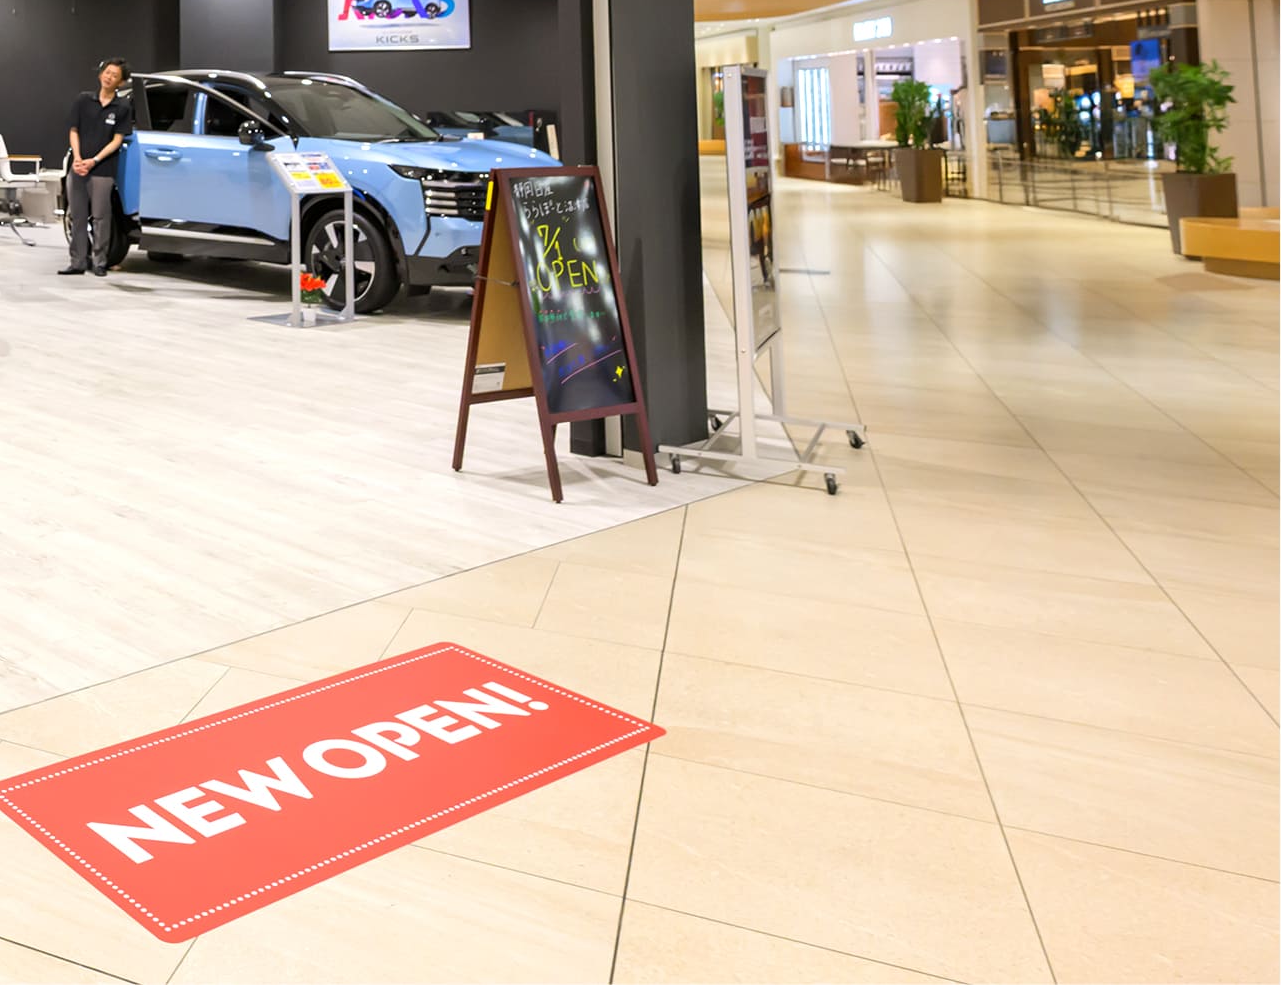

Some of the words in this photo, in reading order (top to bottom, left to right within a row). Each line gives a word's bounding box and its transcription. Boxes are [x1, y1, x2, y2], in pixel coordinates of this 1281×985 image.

[375, 34, 420, 44] KICKS
[537, 259, 599, 292] OPEN
[86, 756, 314, 864] NEW
[302, 681, 550, 779] OPEN!
